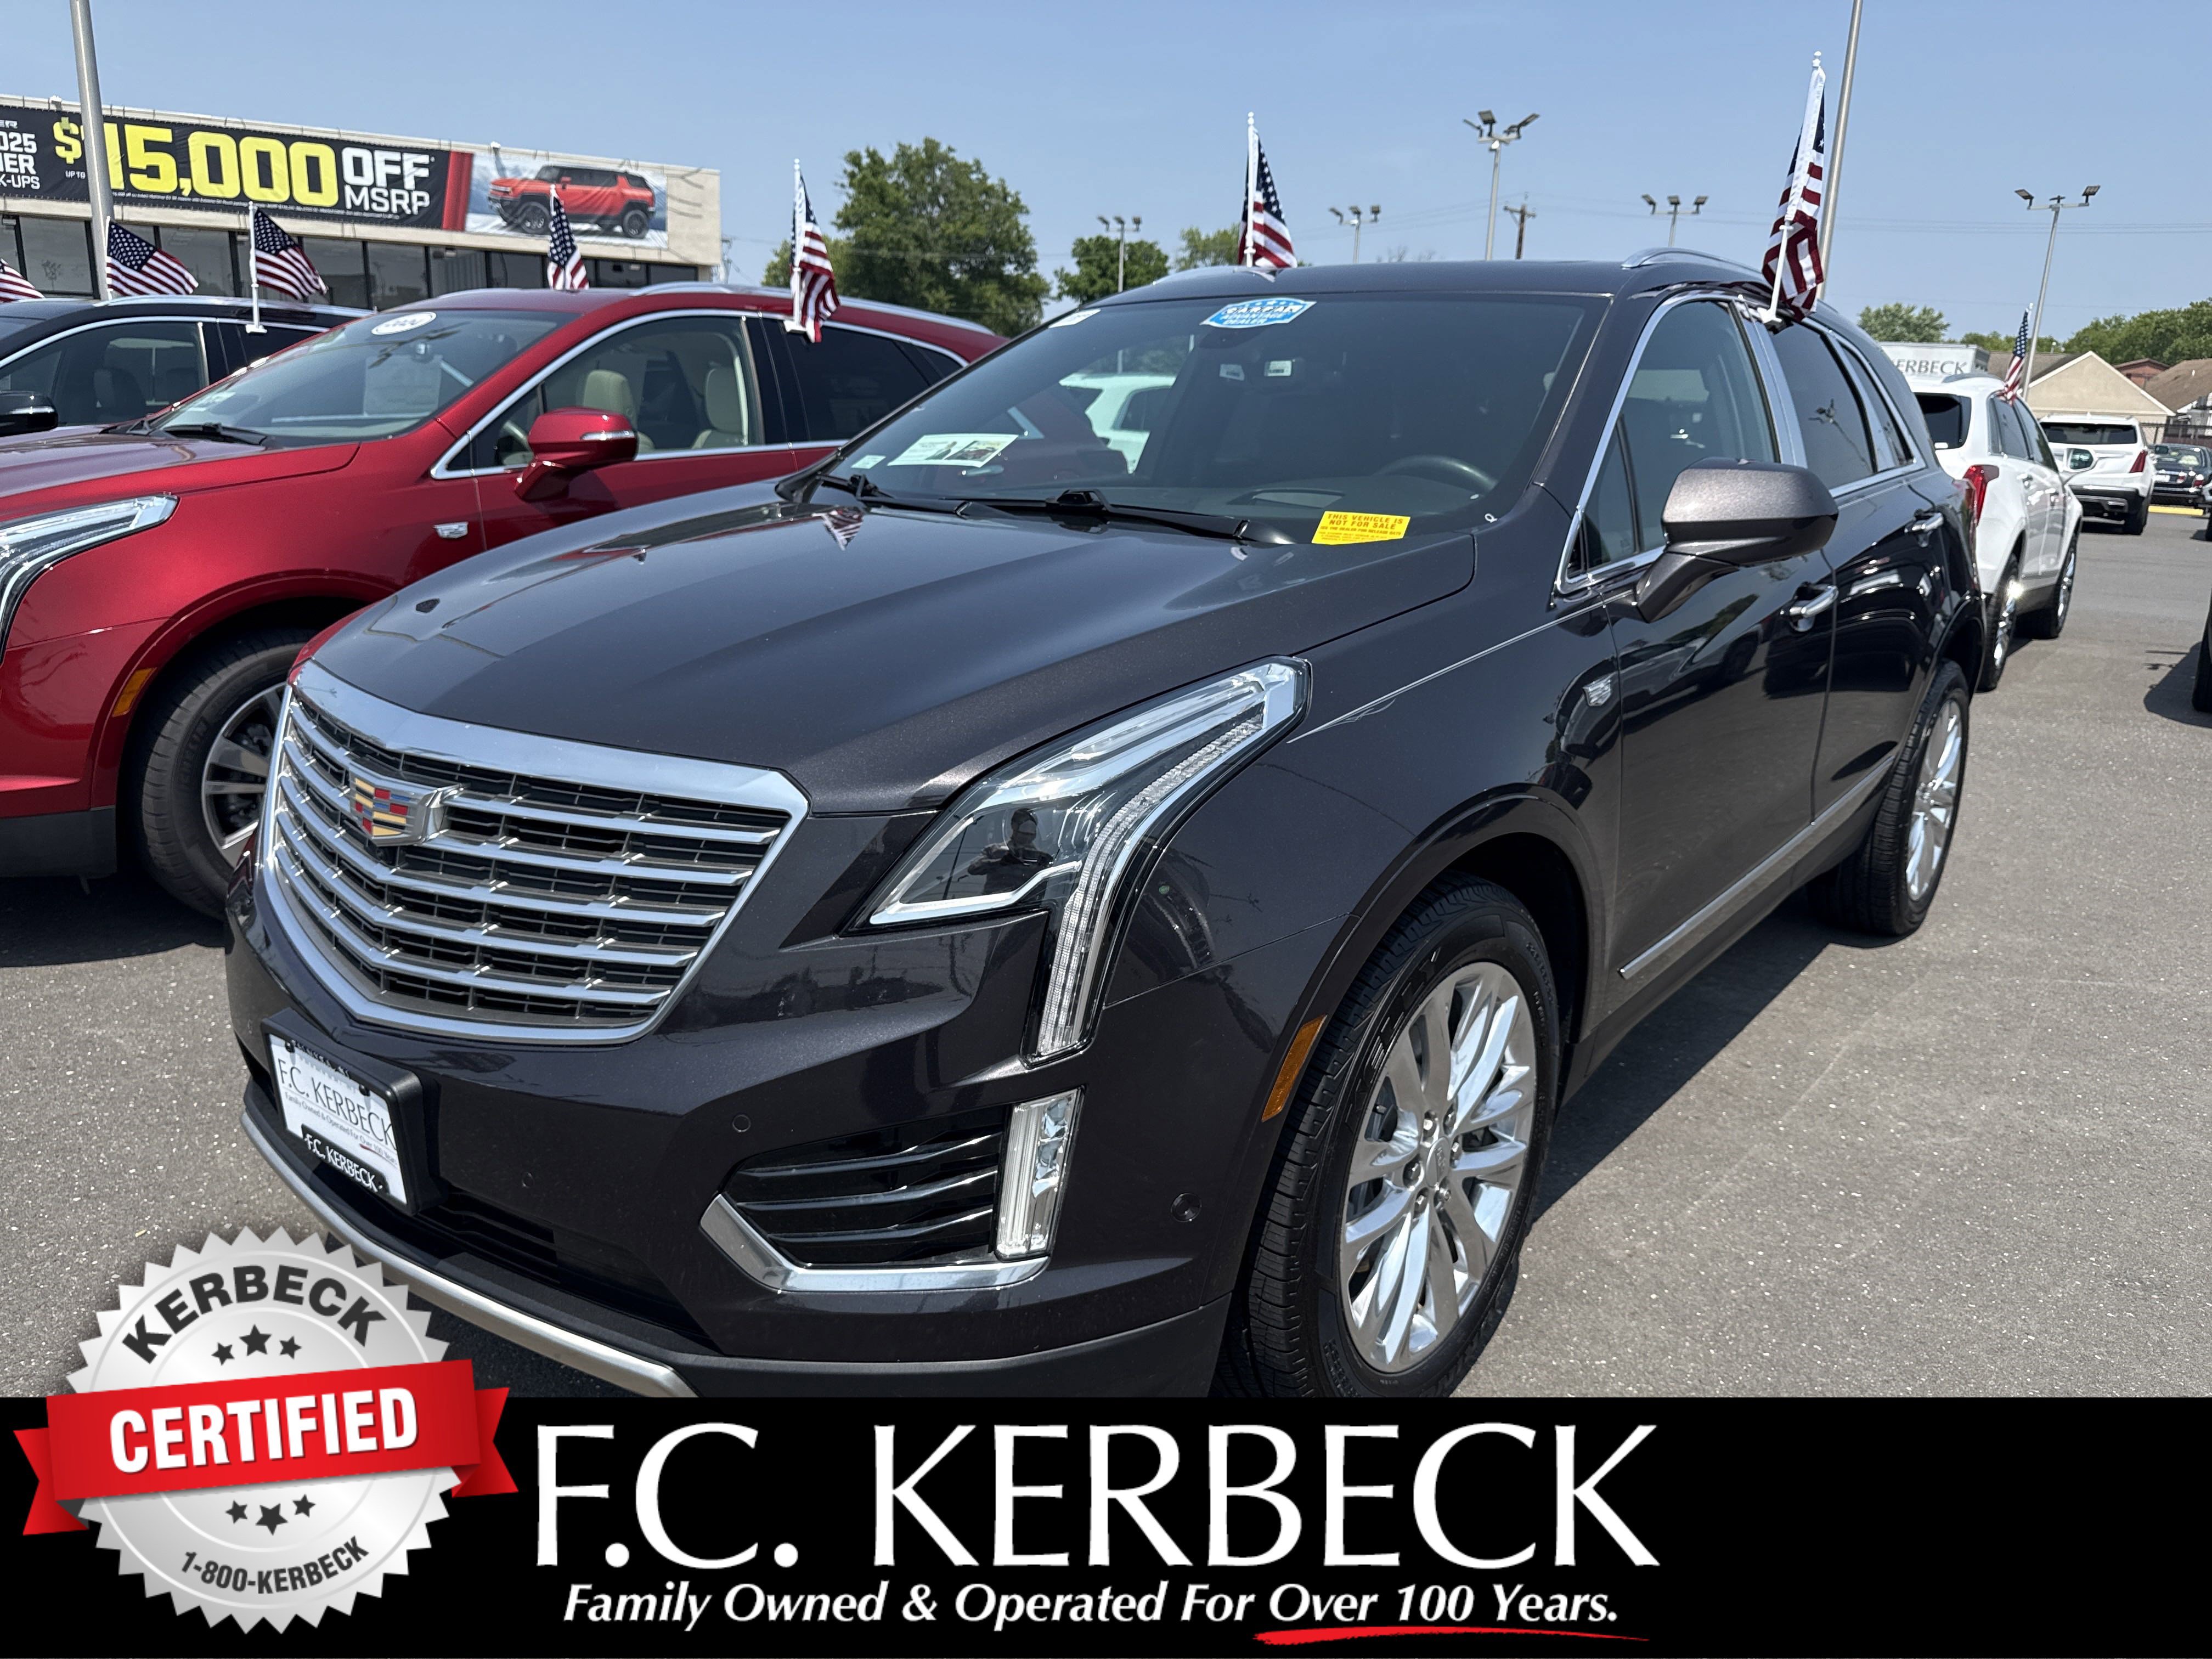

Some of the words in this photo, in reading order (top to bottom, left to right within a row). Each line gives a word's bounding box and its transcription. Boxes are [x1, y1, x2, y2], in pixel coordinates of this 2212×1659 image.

[76, 171, 86, 179] TO
[344, 184, 431, 216] MSRP
[1892, 359, 1968, 374] ERBECK
[278, 1058, 309, 1098] F.C.
[311, 1077, 397, 1151] KERBECK
[325, 1146, 379, 1193] KERBECK
